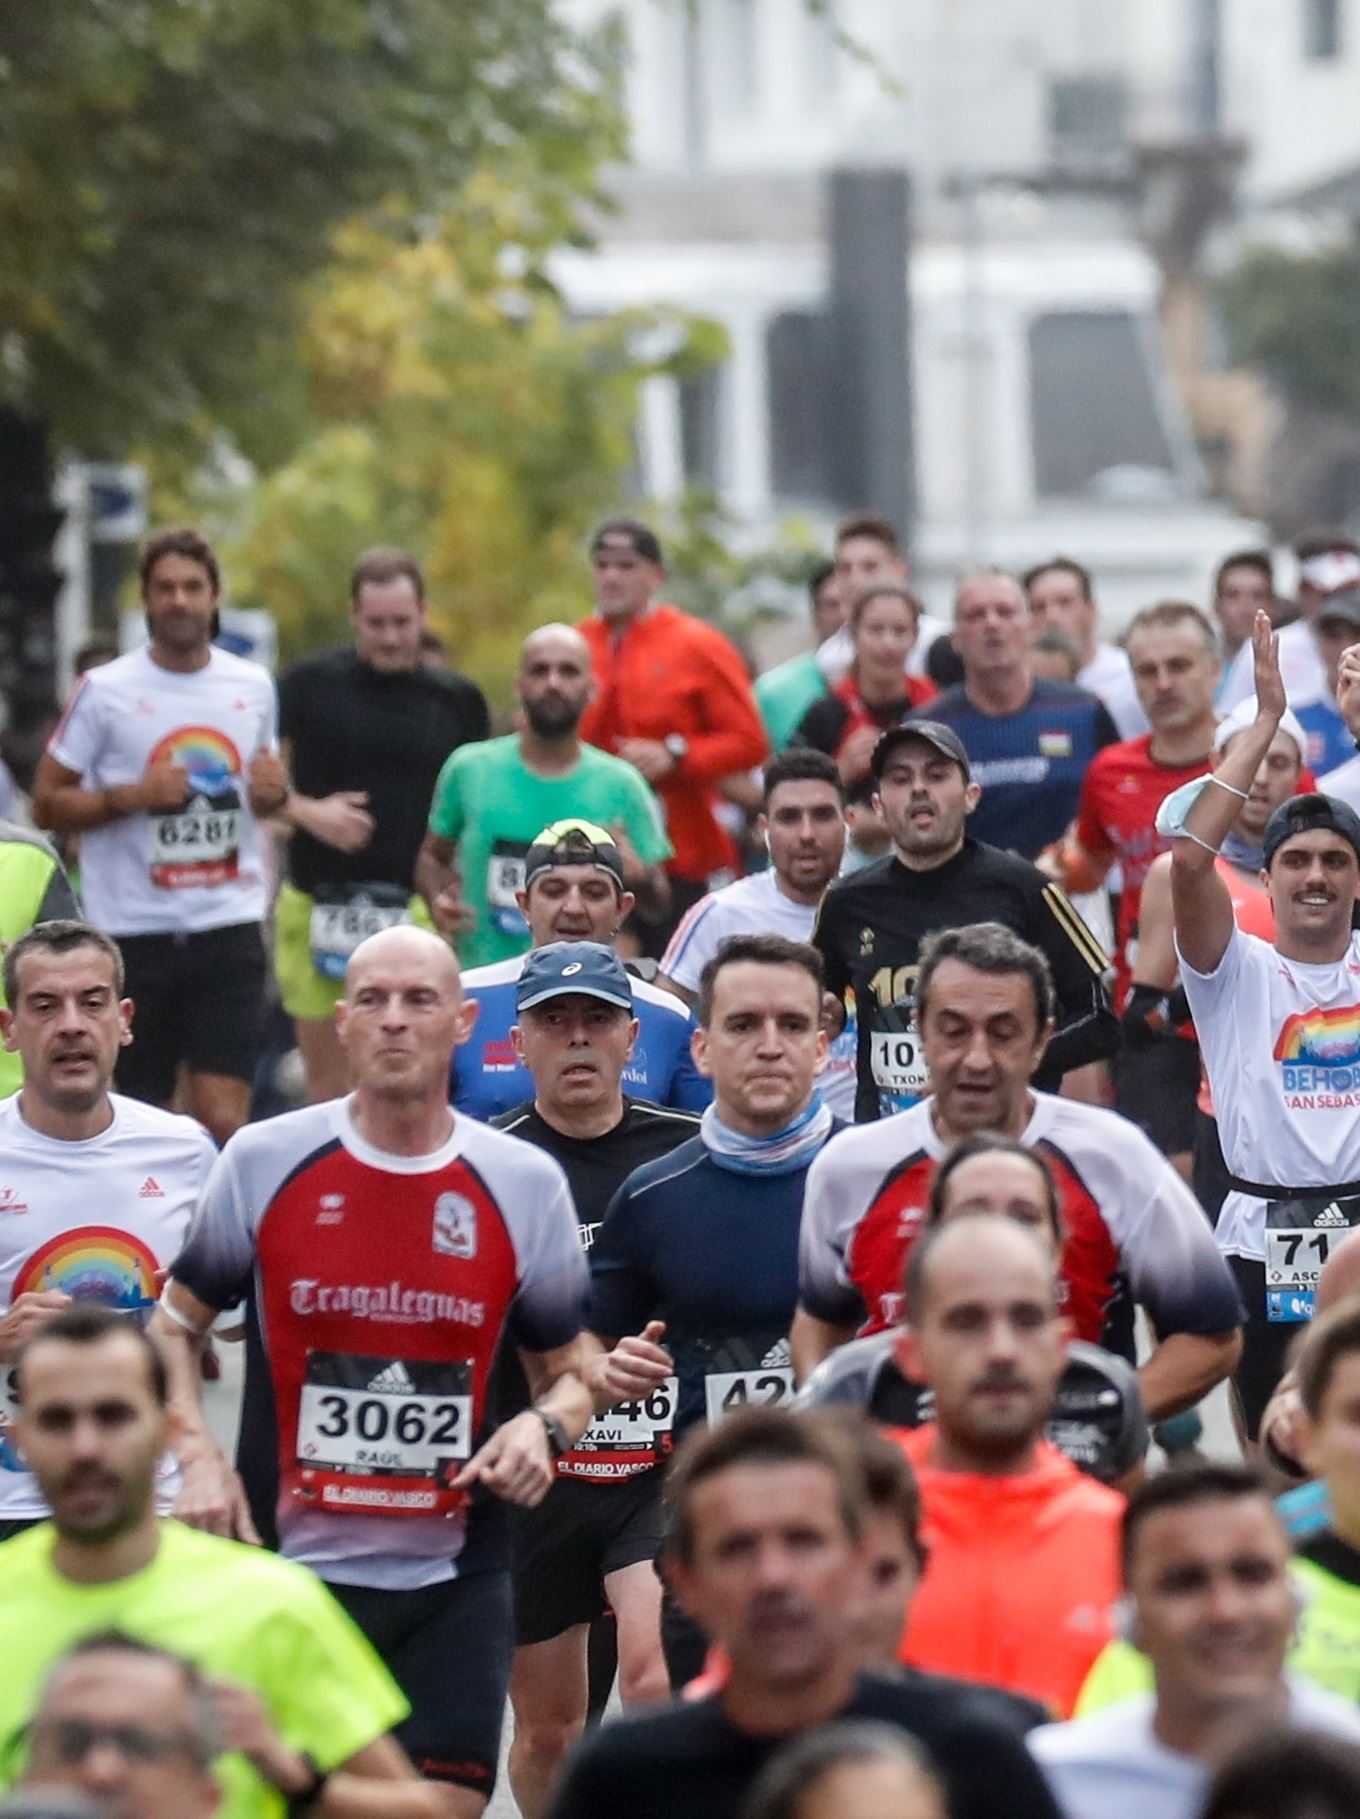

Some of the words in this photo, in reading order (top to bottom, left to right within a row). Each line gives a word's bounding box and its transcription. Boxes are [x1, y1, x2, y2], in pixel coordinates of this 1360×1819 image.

[316, 1396, 460, 1445] 3062
[595, 1385, 671, 1422] 46
[557, 1461, 573, 1472] EL
[574, 1462, 615, 1474] DIARIO
